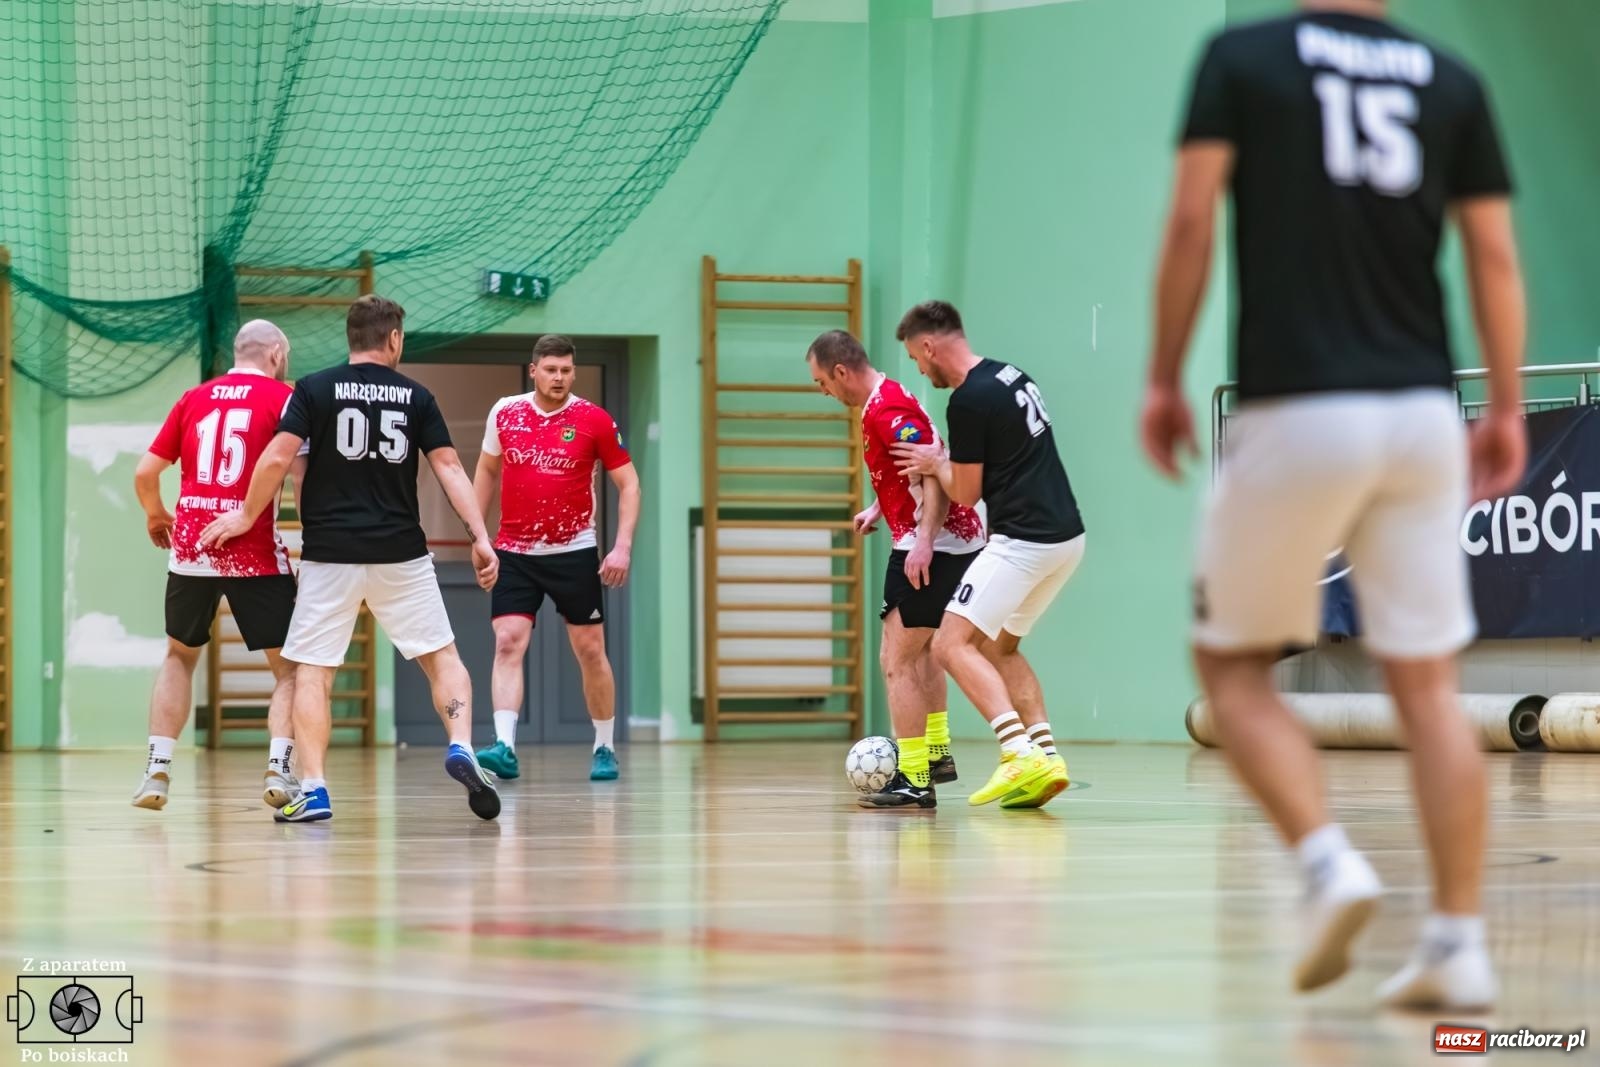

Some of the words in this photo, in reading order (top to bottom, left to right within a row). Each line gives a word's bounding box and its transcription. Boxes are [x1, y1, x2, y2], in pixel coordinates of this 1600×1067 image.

[1312, 72, 1423, 197] 15
[210, 384, 252, 400] START
[335, 382, 412, 405] NARZĘDZIOWY
[196, 407, 253, 488] 15
[336, 407, 410, 464] 0.5
[505, 447, 578, 469] Wiktoria
